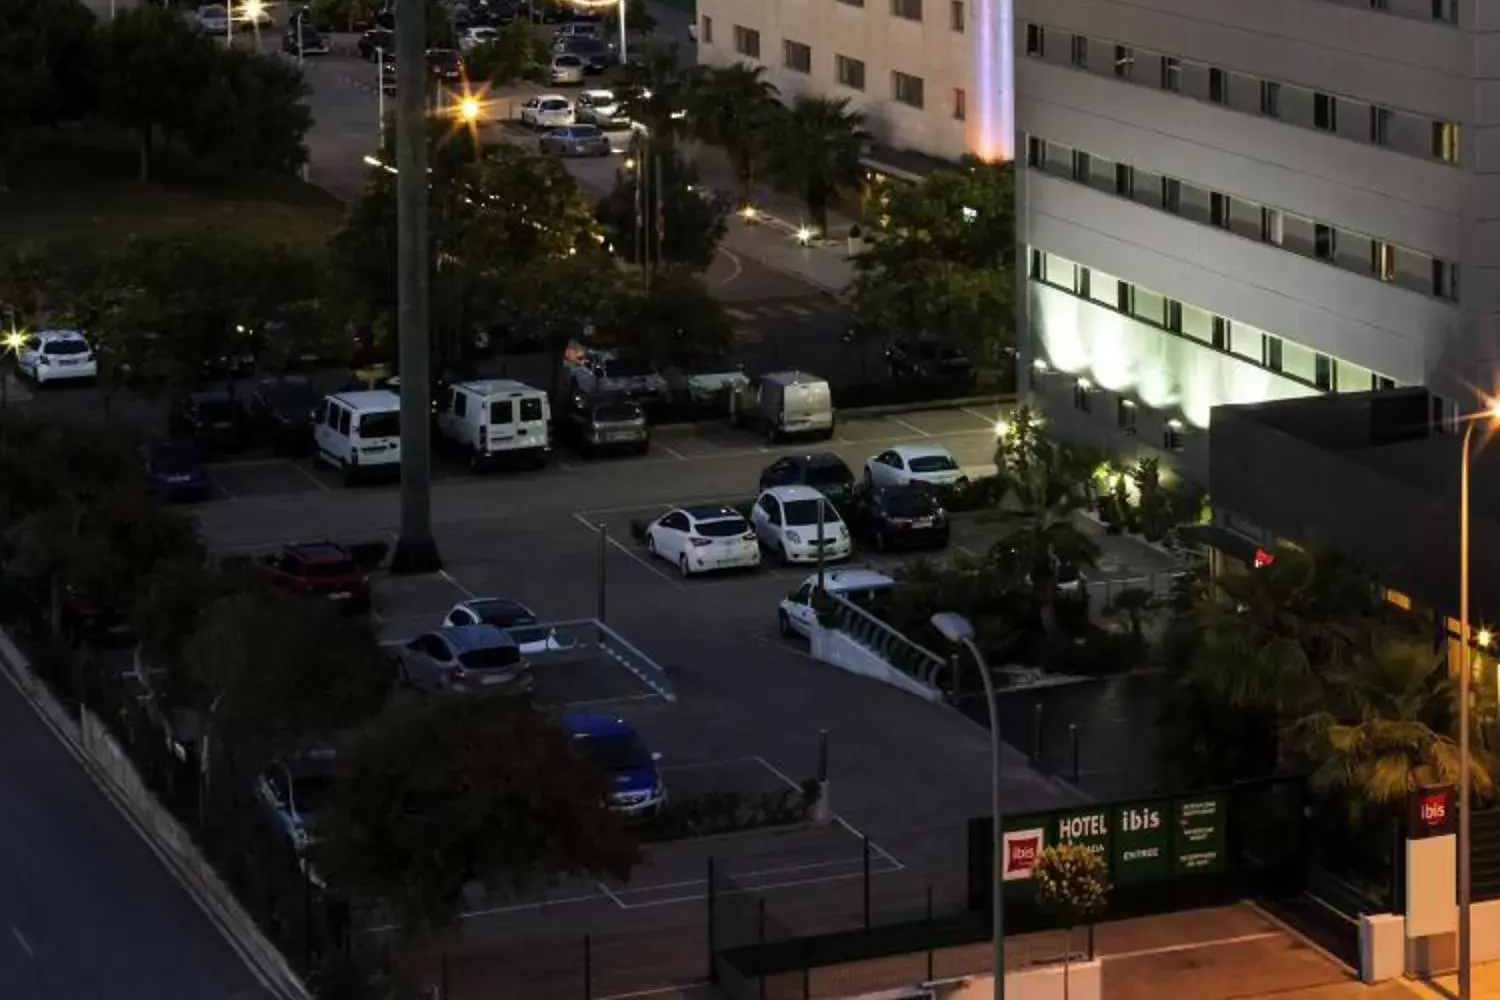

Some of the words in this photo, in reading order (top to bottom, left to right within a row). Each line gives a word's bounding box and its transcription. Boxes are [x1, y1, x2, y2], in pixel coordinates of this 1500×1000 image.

[1060, 815, 1108, 838] HOTEL
[1123, 808, 1160, 832] ibis
[1420, 803, 1445, 820] ibis
